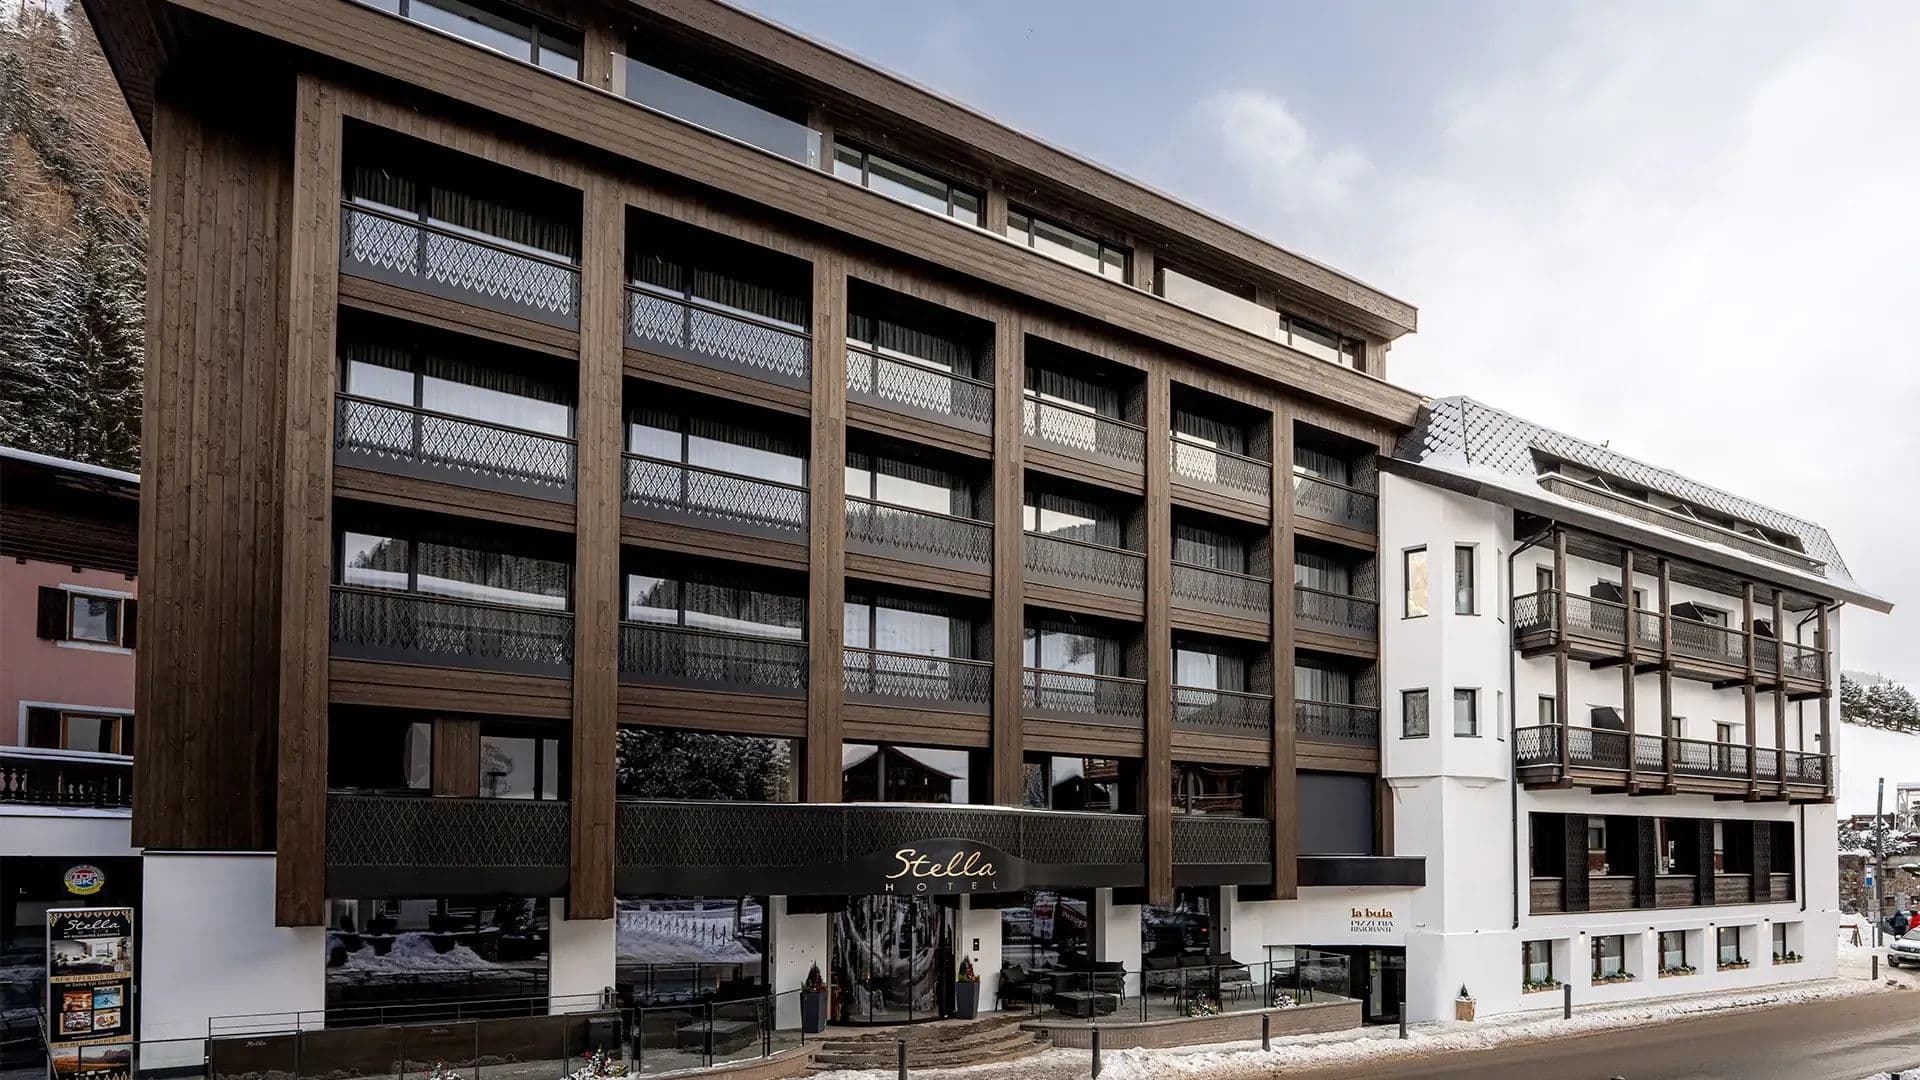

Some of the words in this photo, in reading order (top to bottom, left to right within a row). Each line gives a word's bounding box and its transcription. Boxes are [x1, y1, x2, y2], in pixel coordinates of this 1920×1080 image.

[886, 849, 997, 878] Stella
[885, 882, 997, 891] HOTEL
[1351, 908, 1362, 918] la
[1365, 908, 1393, 918] bula
[63, 919, 120, 931] Stella
